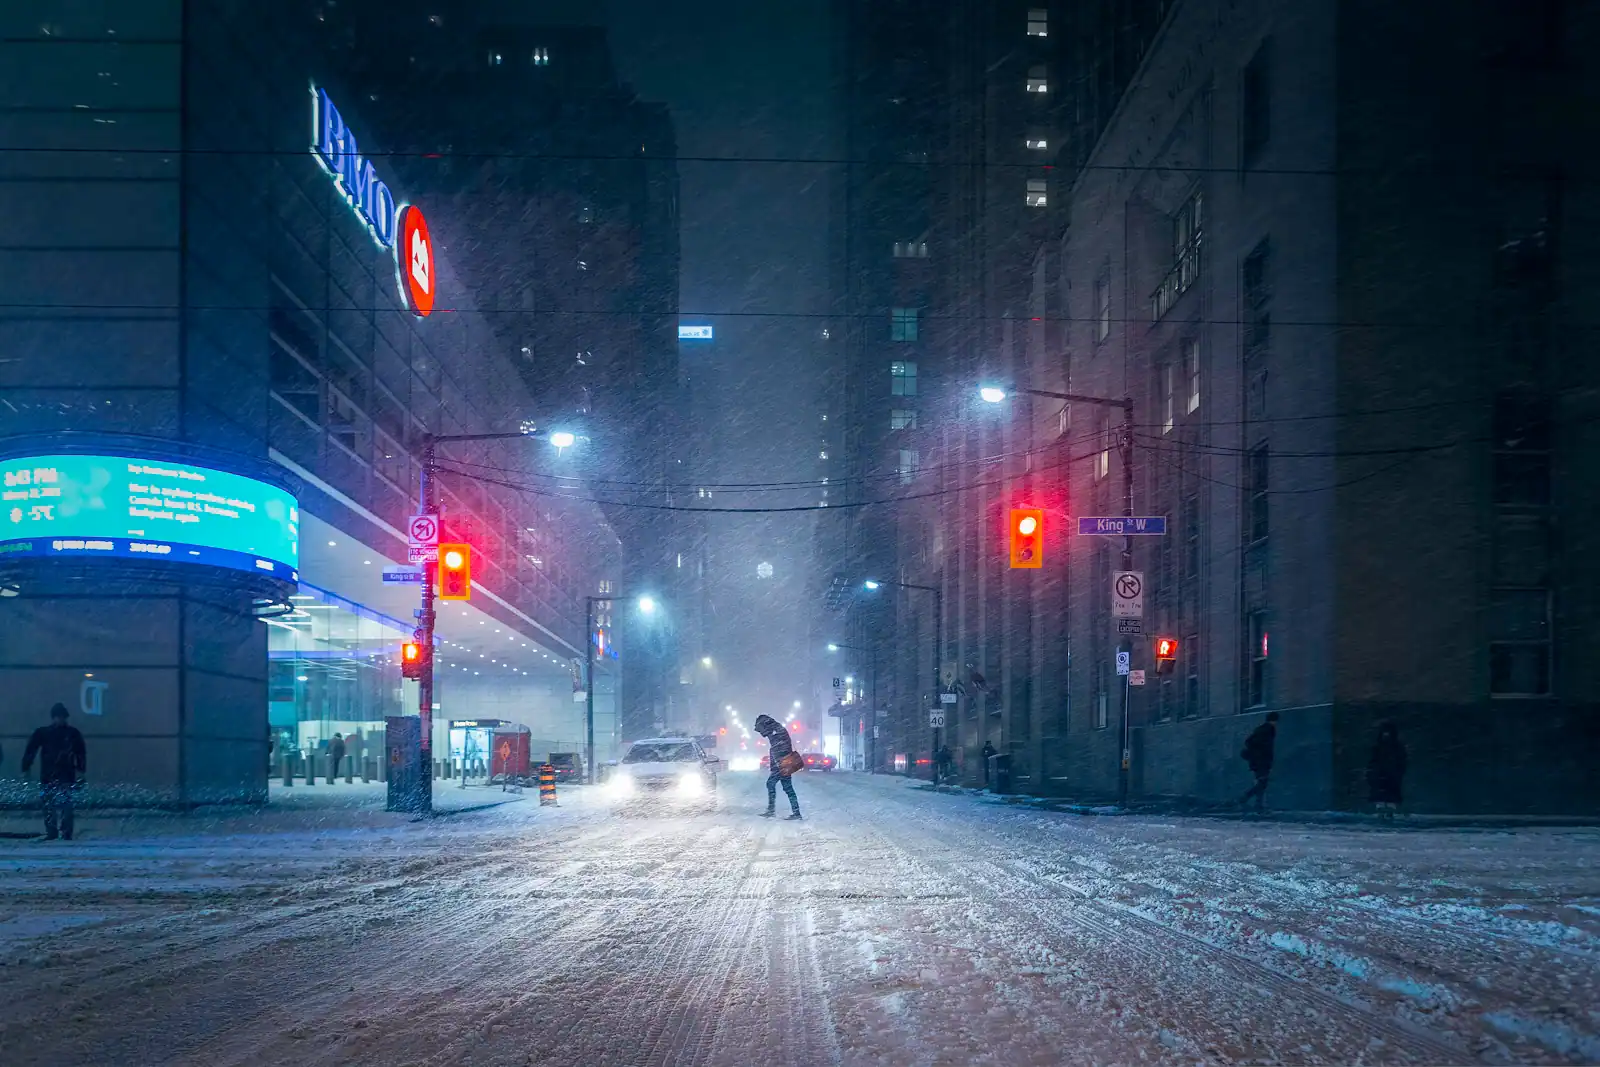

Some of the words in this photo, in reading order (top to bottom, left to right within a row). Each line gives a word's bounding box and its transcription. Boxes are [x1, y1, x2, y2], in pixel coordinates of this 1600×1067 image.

[313, 86, 396, 248] BMO
[1097, 518, 1124, 533] King
[1136, 518, 1147, 531] W
[931, 716, 944, 725] 40
